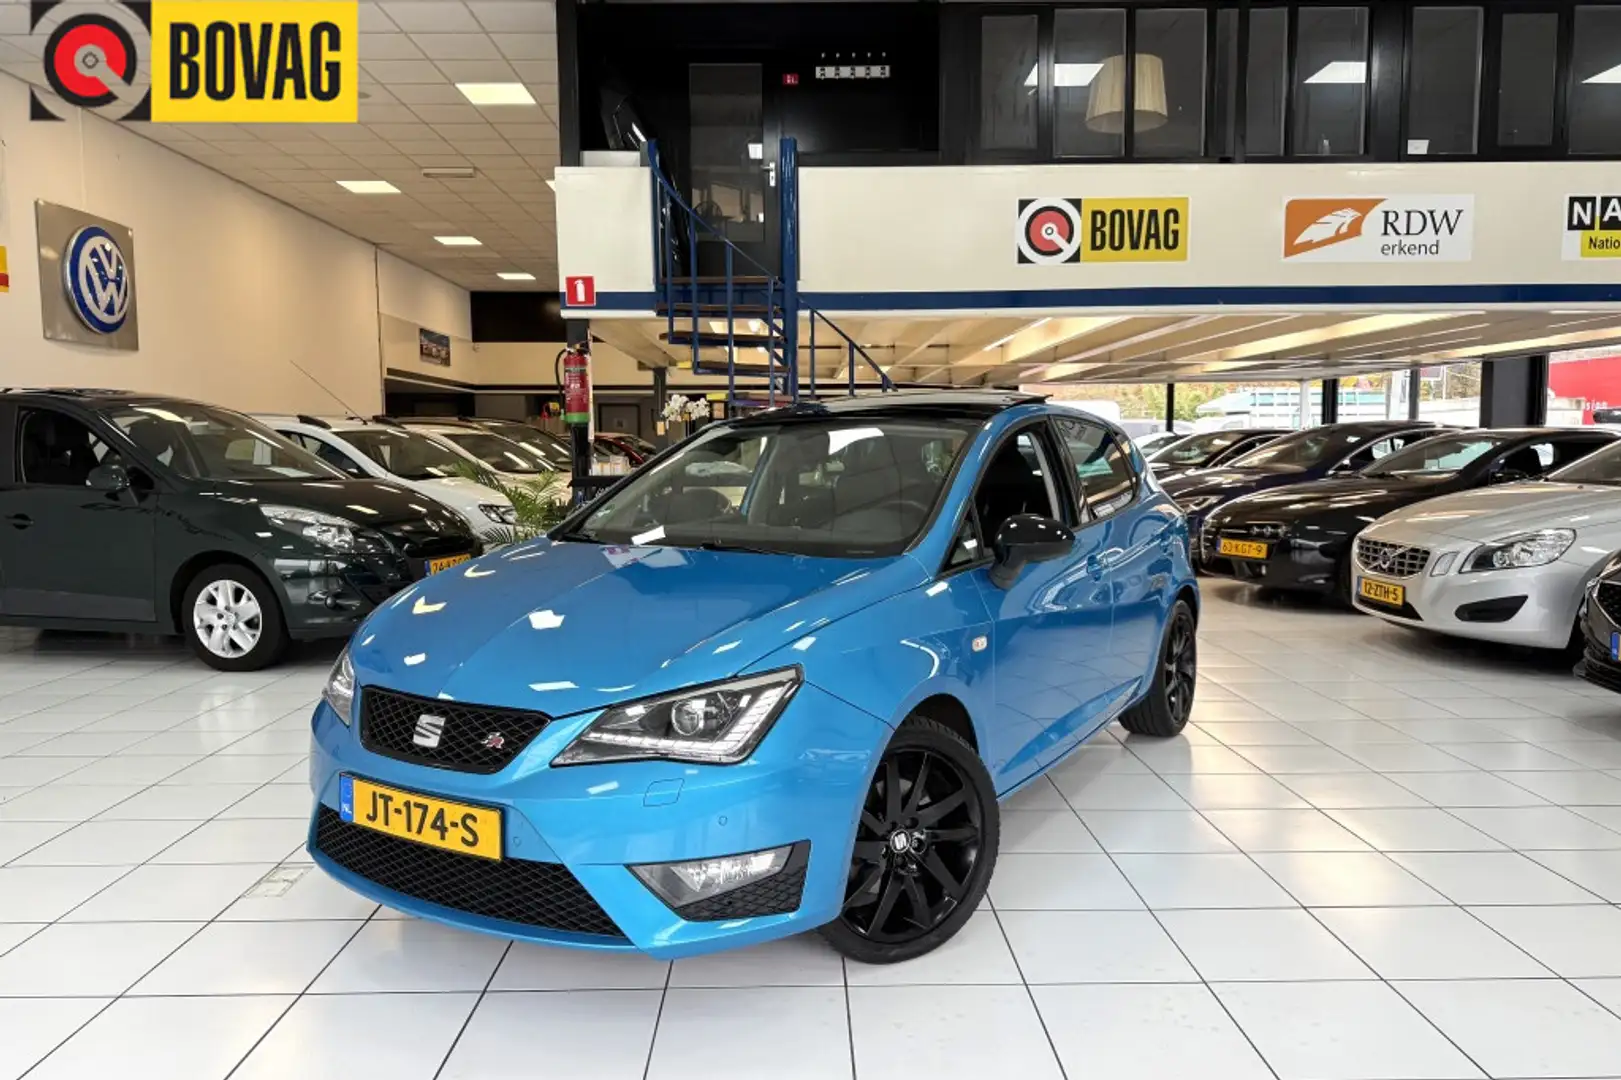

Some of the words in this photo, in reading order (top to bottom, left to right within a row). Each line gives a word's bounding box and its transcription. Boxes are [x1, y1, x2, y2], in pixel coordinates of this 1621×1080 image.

[1090, 208, 1180, 251] BOVAG
[1381, 209, 1464, 236] RDW
[1380, 239, 1440, 256] erkend
[1588, 236, 1621, 250] Natio
[1363, 581, 1400, 601] 12-ZTH-5
[366, 790, 479, 847] JT-174-S
